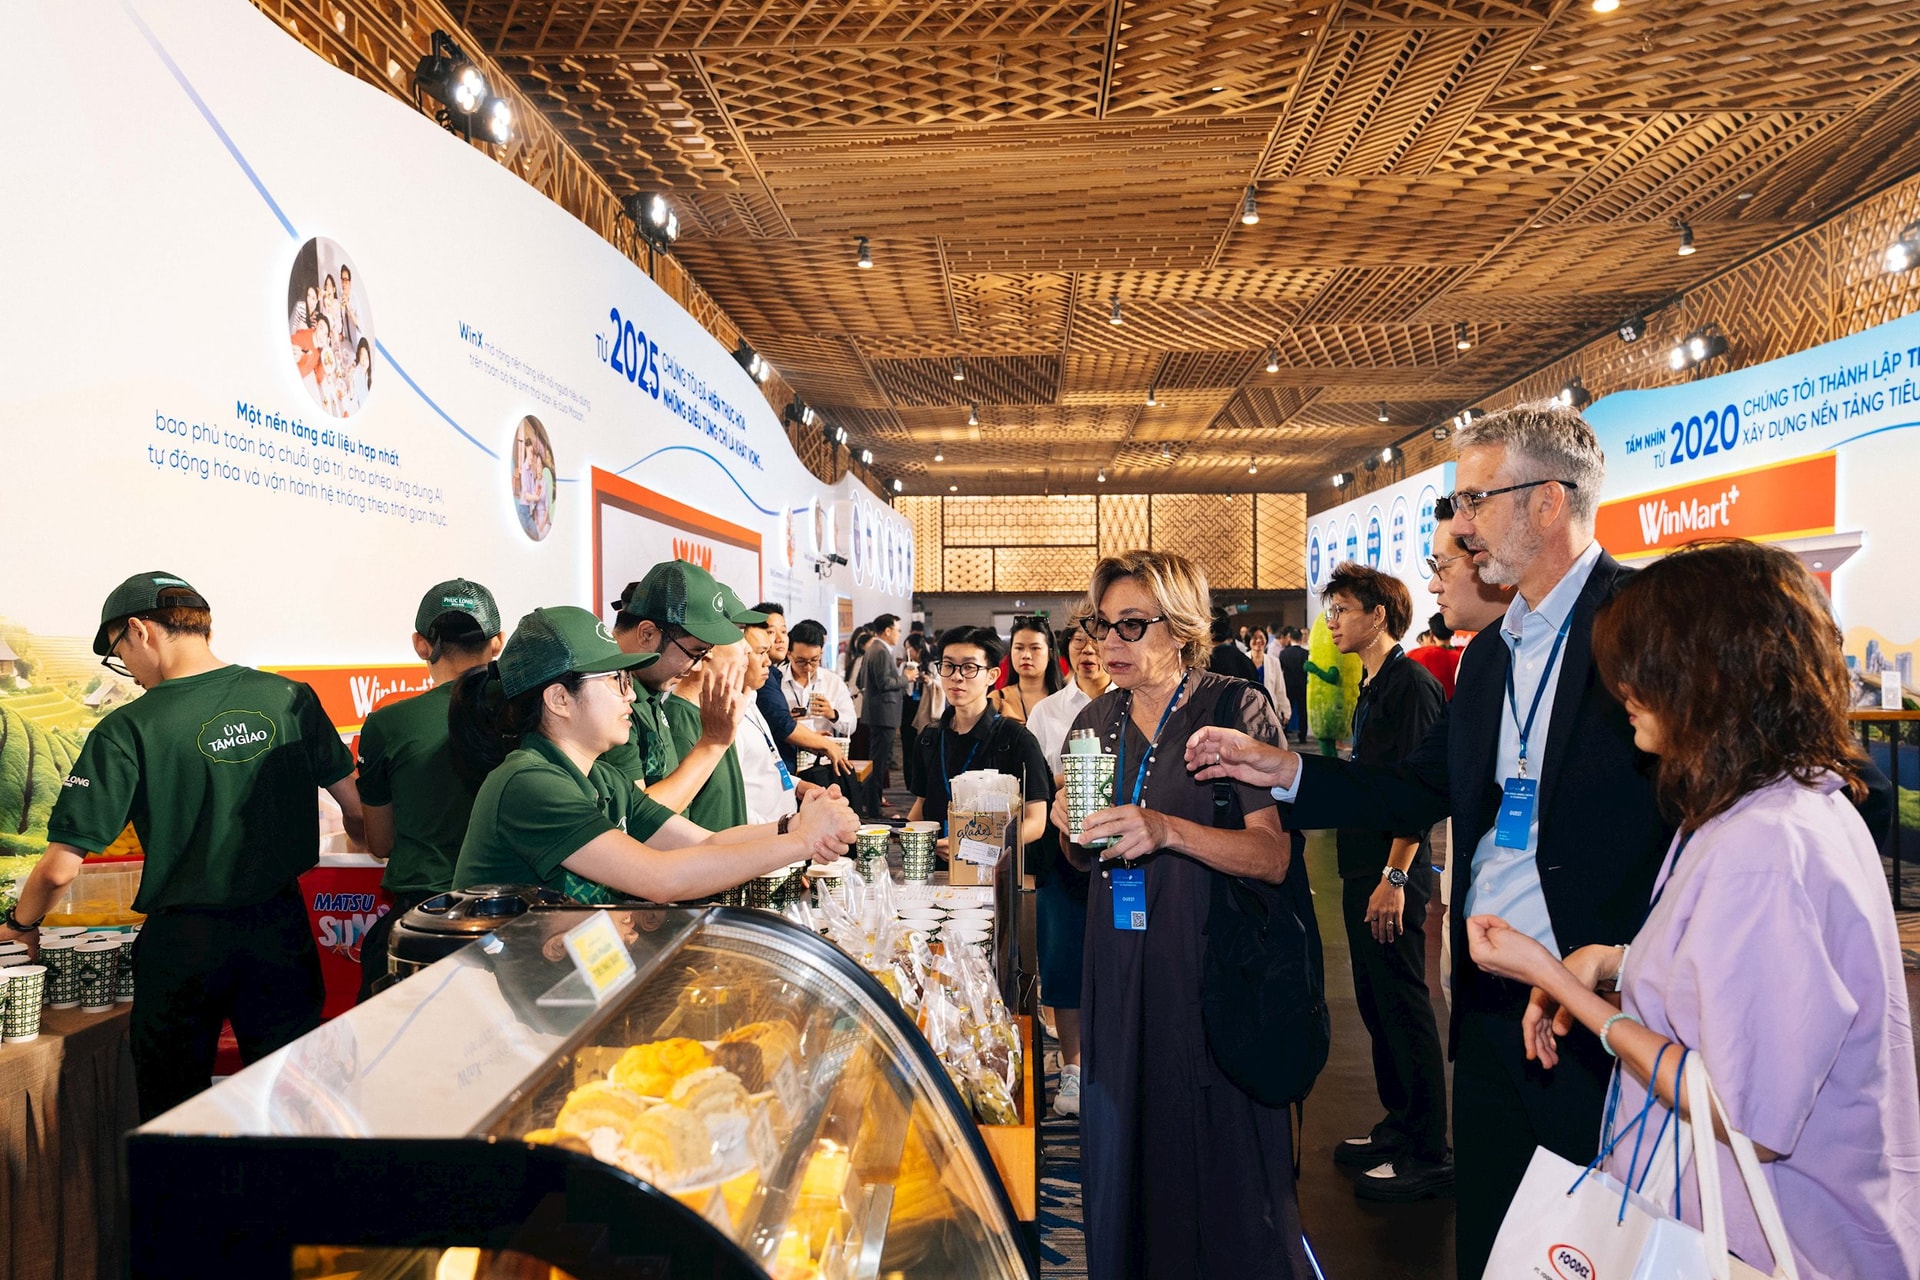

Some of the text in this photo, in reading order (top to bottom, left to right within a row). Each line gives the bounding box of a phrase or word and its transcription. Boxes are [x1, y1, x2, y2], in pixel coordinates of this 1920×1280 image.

[459, 320, 483, 349] WinX
[596, 307, 660, 400] TỪ 2025
[662, 352, 687, 388] CHÚNG
[1743, 388, 1789, 417] CHÚNG
[1792, 377, 1816, 402] TÔI
[1819, 364, 1868, 394] THÀNH
[1873, 351, 1902, 381] LẬP
[237, 400, 262, 430] Một
[265, 411, 288, 434] nền
[291, 418, 318, 447] tảng
[321, 429, 335, 447] dữ
[338, 432, 356, 456] liệu
[358, 439, 377, 463] hợp
[1644, 427, 1666, 449] NHÌN
[1654, 403, 1740, 470] TỪ 2020
[1743, 421, 1765, 446] XÂY
[1768, 413, 1807, 442] DỰNG
[1811, 400, 1839, 429] NỀN
[1843, 391, 1885, 420] TẢNG
[148, 443, 166, 470] tự
[169, 448, 209, 480] động
[213, 457, 241, 481] hóa
[244, 467, 260, 486] và
[263, 471, 287, 494] vận
[289, 475, 318, 499] hành
[320, 482, 334, 506] hệ
[336, 487, 366, 513] thống
[367, 496, 389, 514] theo
[409, 506, 428, 524] gian
[156, 409, 188, 437] bao
[192, 421, 220, 445] phủ
[224, 430, 256, 454] toàn
[259, 437, 276, 463] bộ
[279, 445, 310, 469] chuỗi
[313, 455, 331, 476] giá
[348, 465, 367, 484] cho
[368, 470, 392, 492] phép
[412, 480, 433, 504] dụng
[208, 730, 268, 752] TÂM GIAO
[313, 892, 376, 912] MATSU
